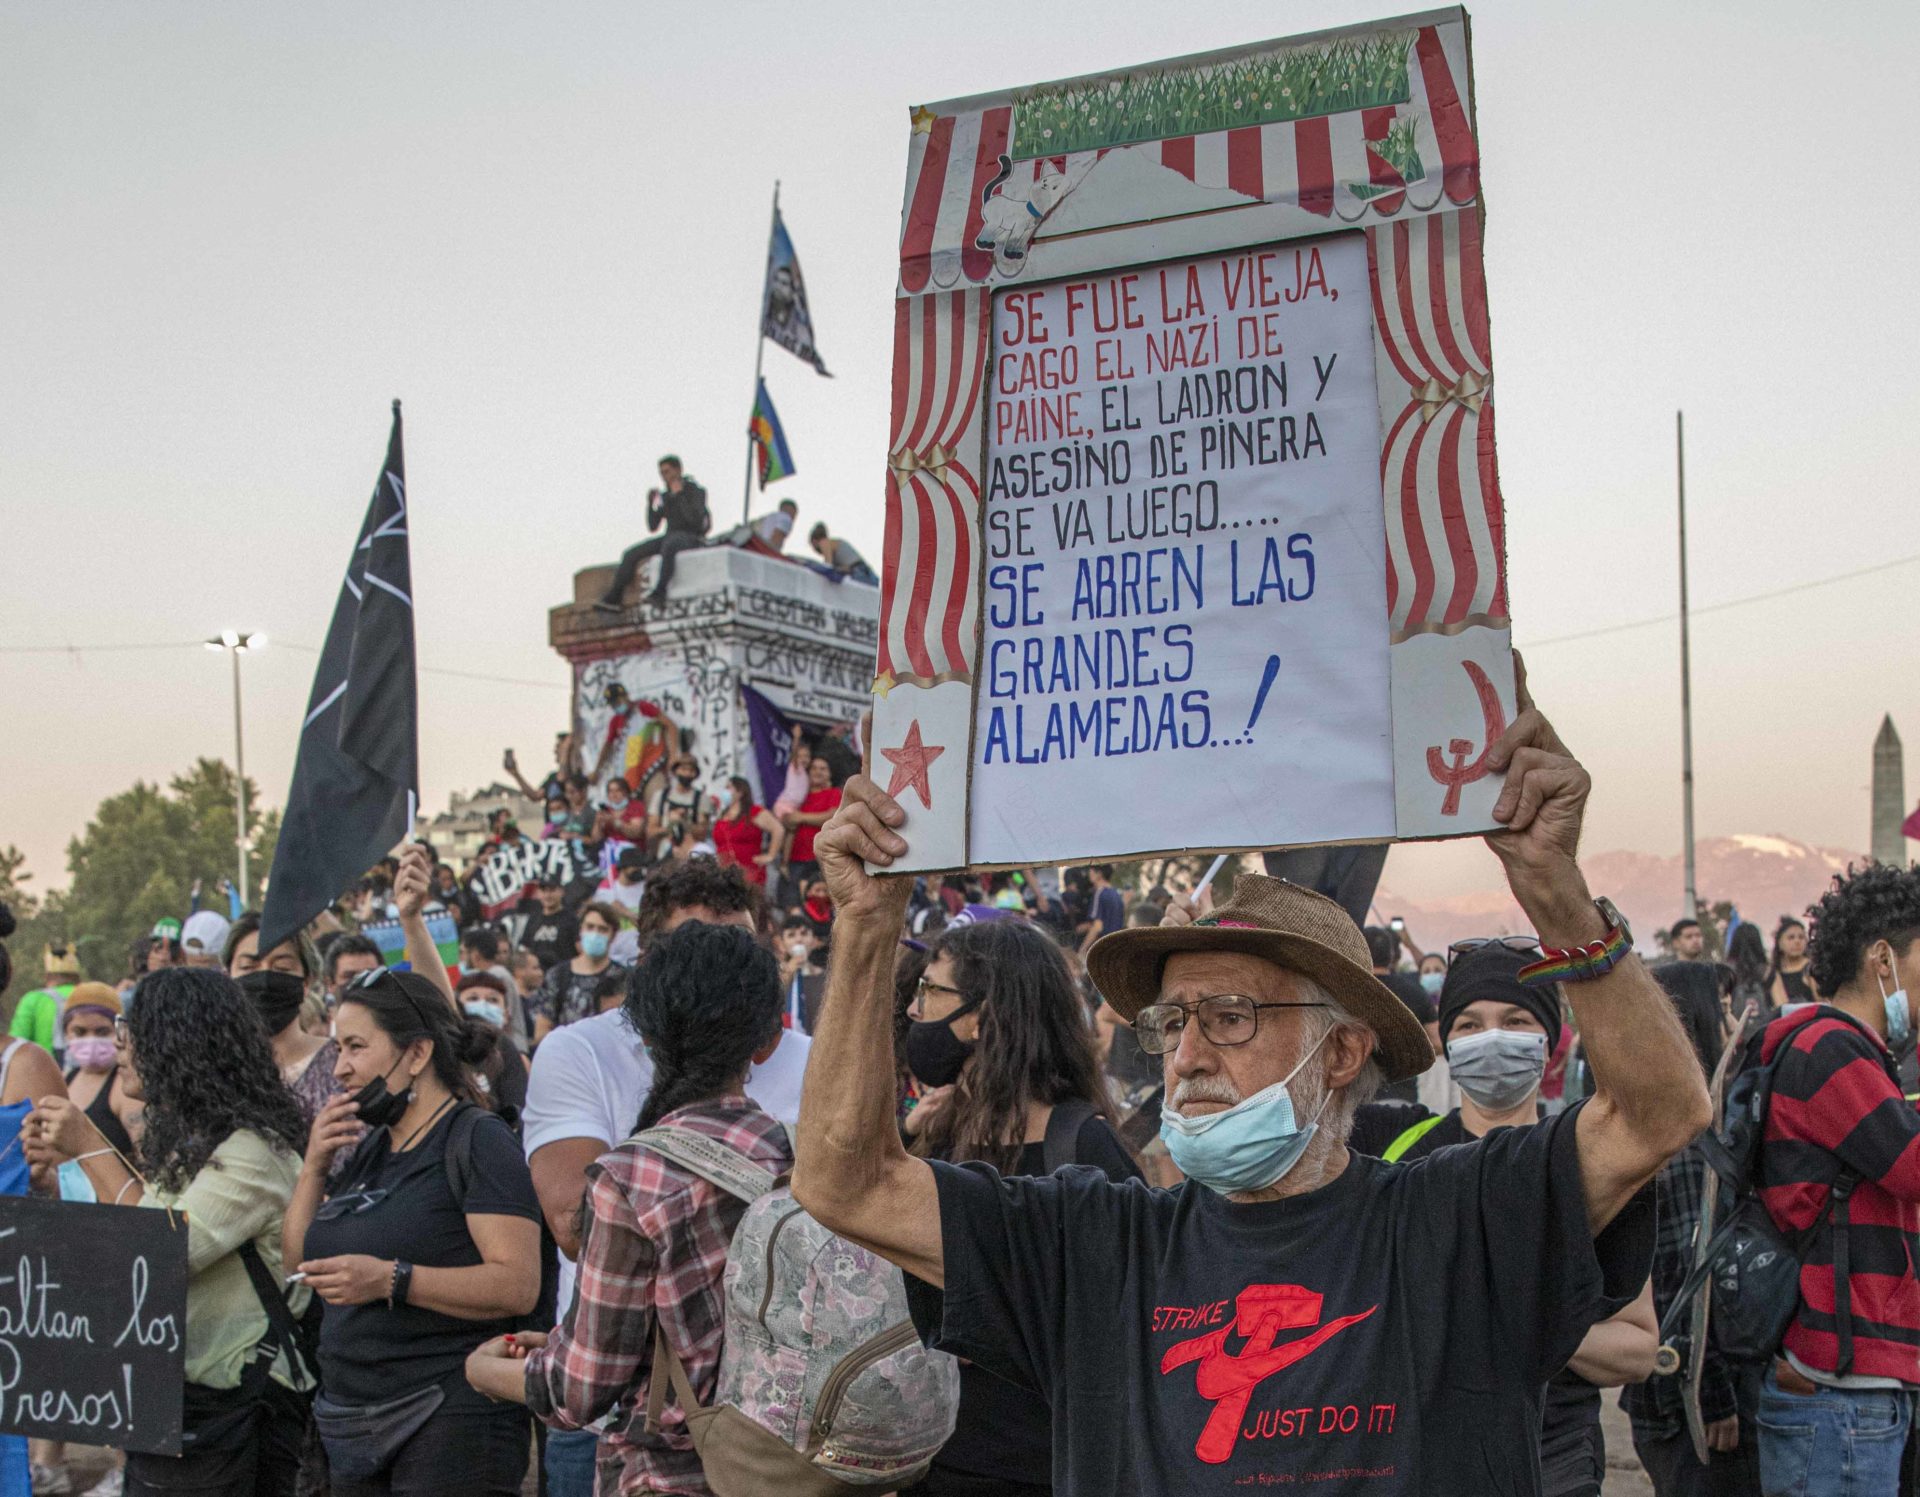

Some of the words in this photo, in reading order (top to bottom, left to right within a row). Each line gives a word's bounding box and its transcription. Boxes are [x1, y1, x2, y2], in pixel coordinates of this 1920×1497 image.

[1002, 291, 1049, 347] SE
[1066, 274, 1144, 337] FUE
[1159, 264, 1206, 324] LA
[1221, 246, 1340, 311] VIEJA,
[996, 391, 1094, 446] PAINE,
[1102, 384, 1141, 433] EL
[1157, 360, 1288, 426] LADRON
[1312, 352, 1338, 402] Y
[998, 344, 1079, 395] CAGO
[1095, 338, 1135, 381] EL
[1145, 314, 1220, 374] NAZI
[1237, 312, 1284, 360] DE
[988, 439, 1131, 502] ASESINO
[1150, 429, 1189, 480] DE
[1201, 411, 1327, 472] PINERA
[988, 507, 1036, 558] SE
[1052, 498, 1095, 551] VA
[988, 562, 1045, 629] SE
[1071, 544, 1204, 621] ABREN
[1230, 532, 1317, 607] LAS
[988, 623, 1195, 700] GRANDES
[0, 1226, 95, 1344] altan
[113, 1254, 180, 1353] los
[1151, 1299, 1229, 1332] STRIKE
[0, 1338, 135, 1431] Presos!
[1243, 1407, 1314, 1440] JUST
[1318, 1404, 1360, 1434] DO
[1367, 1402, 1397, 1434] IT!
